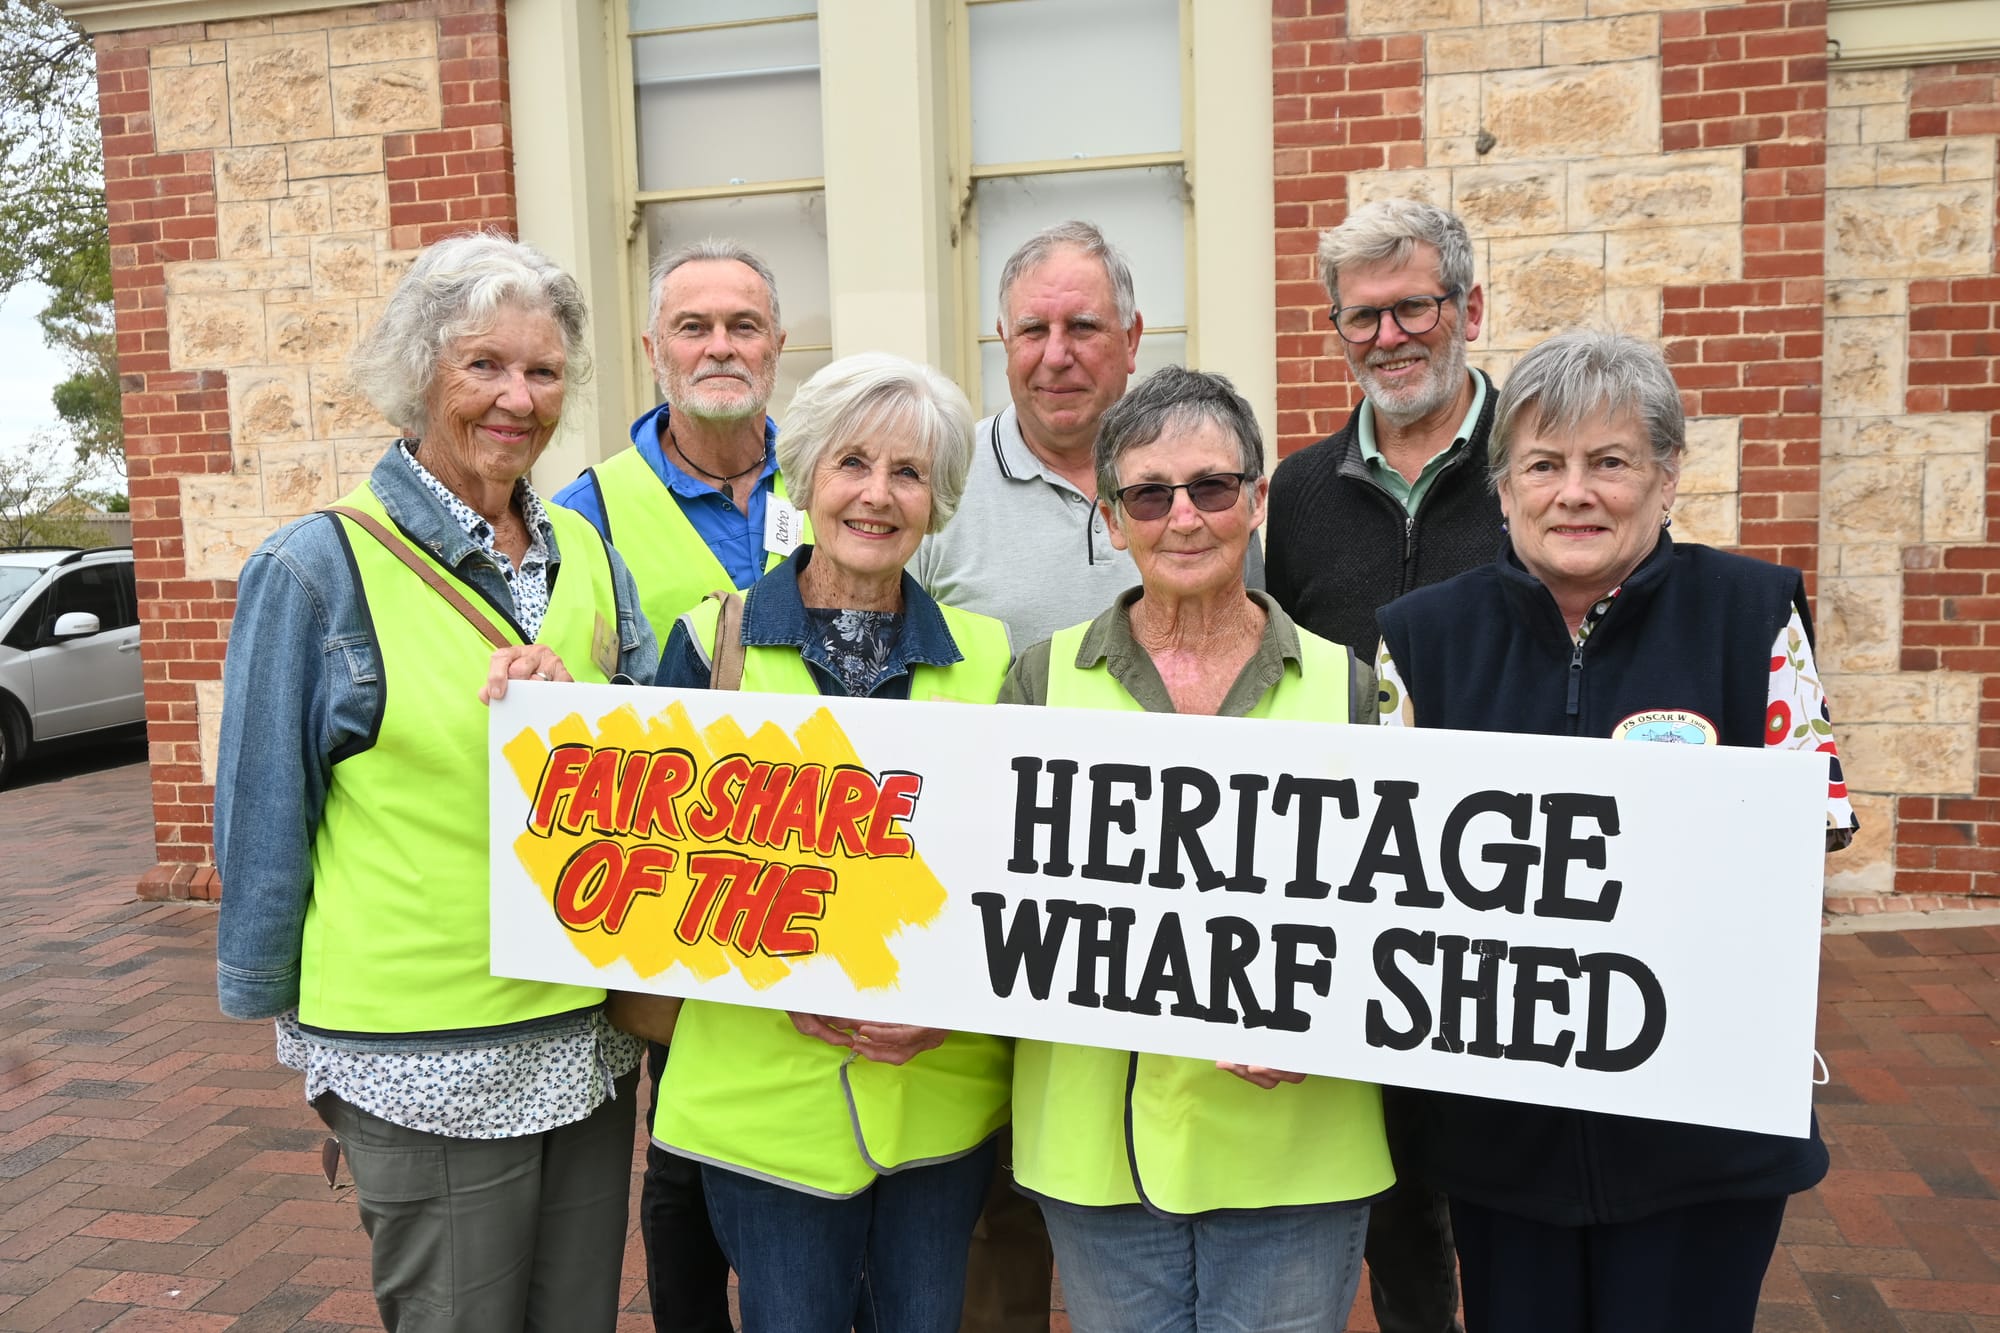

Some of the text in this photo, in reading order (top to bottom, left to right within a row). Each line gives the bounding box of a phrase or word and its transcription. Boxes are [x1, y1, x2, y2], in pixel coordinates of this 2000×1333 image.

[1623, 719, 1635, 730] PS
[1638, 713, 1674, 723] OSCAR
[527, 743, 923, 858] FAIR SHARE
[1007, 756, 1623, 923] HERITAGE
[554, 839, 837, 957] OF THE
[971, 892, 1667, 1073] WHARF SHED
